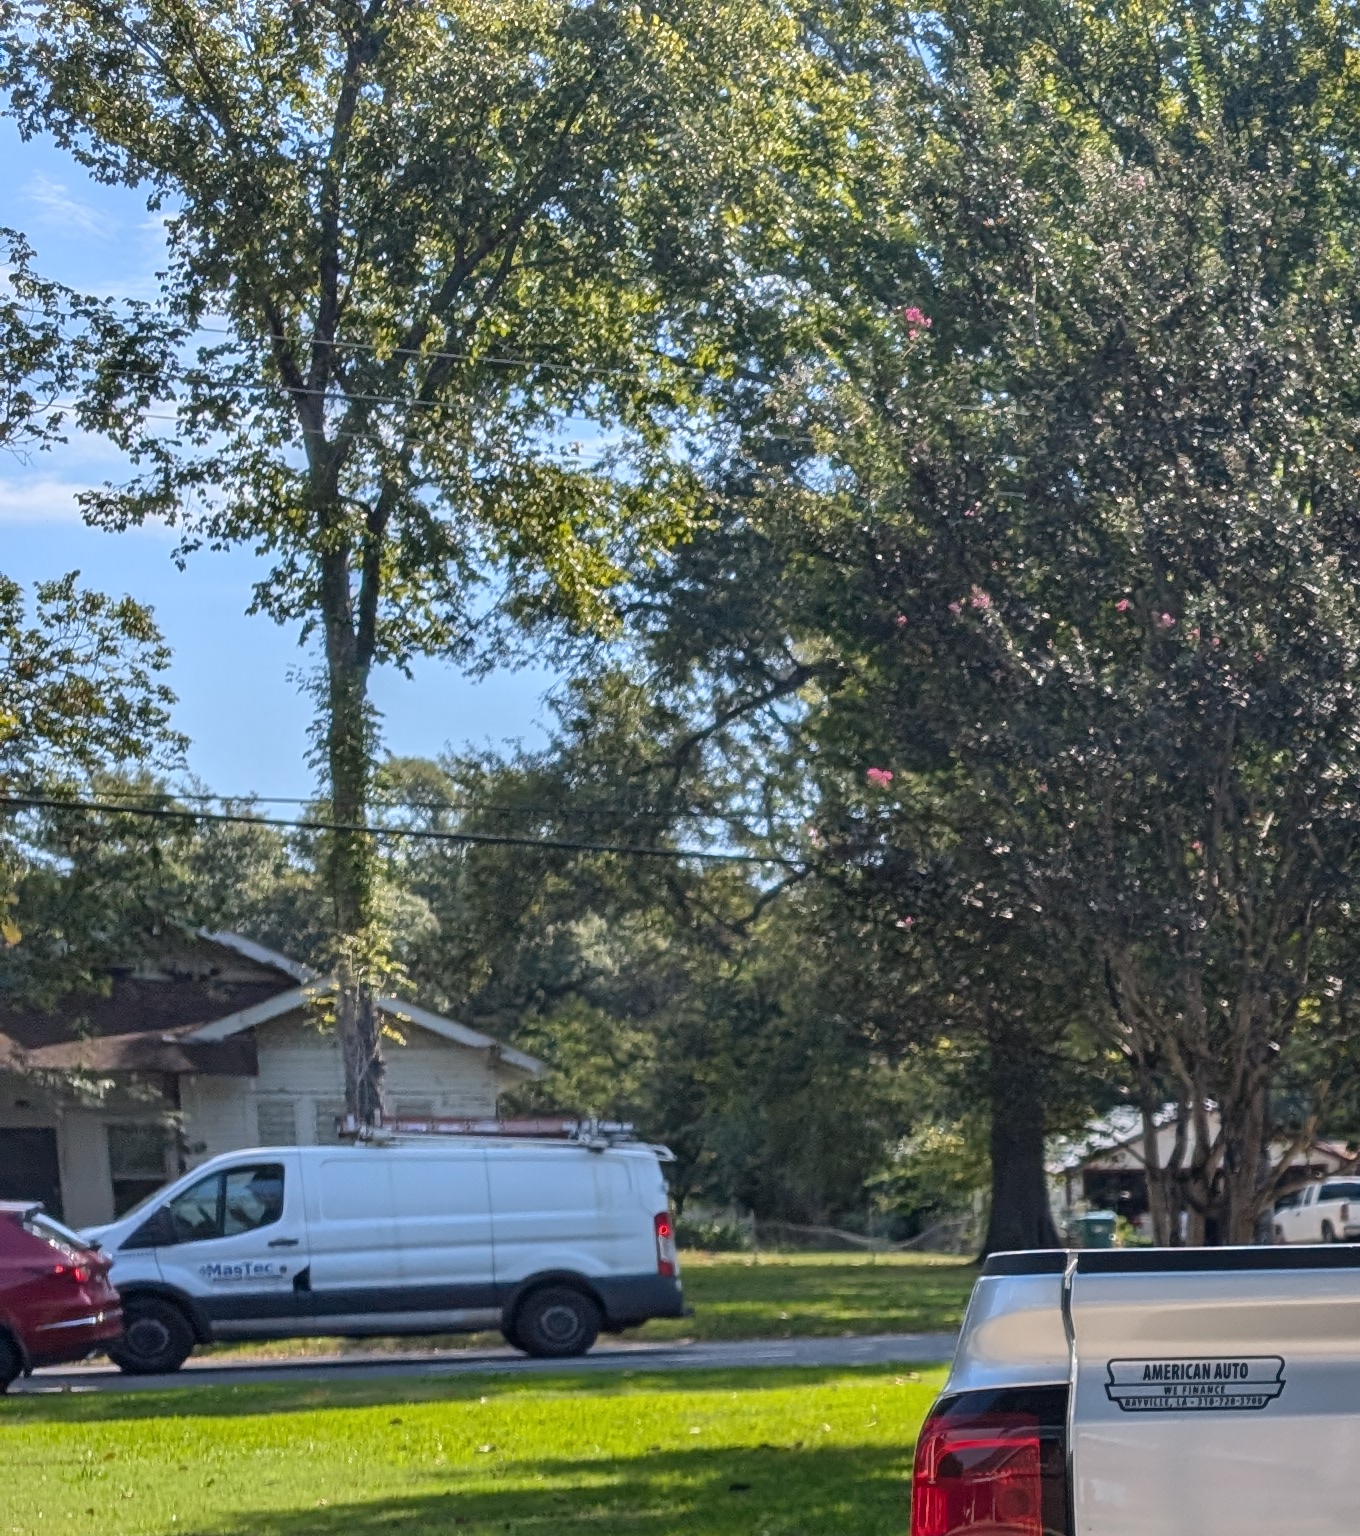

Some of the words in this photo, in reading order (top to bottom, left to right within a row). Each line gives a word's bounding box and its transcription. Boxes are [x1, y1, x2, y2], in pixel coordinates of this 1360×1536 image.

[1143, 1363, 1211, 1381] AMERICAN
[1213, 1362, 1249, 1380] AUTO
[1163, 1386, 1178, 1396] WE
[1182, 1385, 1226, 1395] FINANCE
